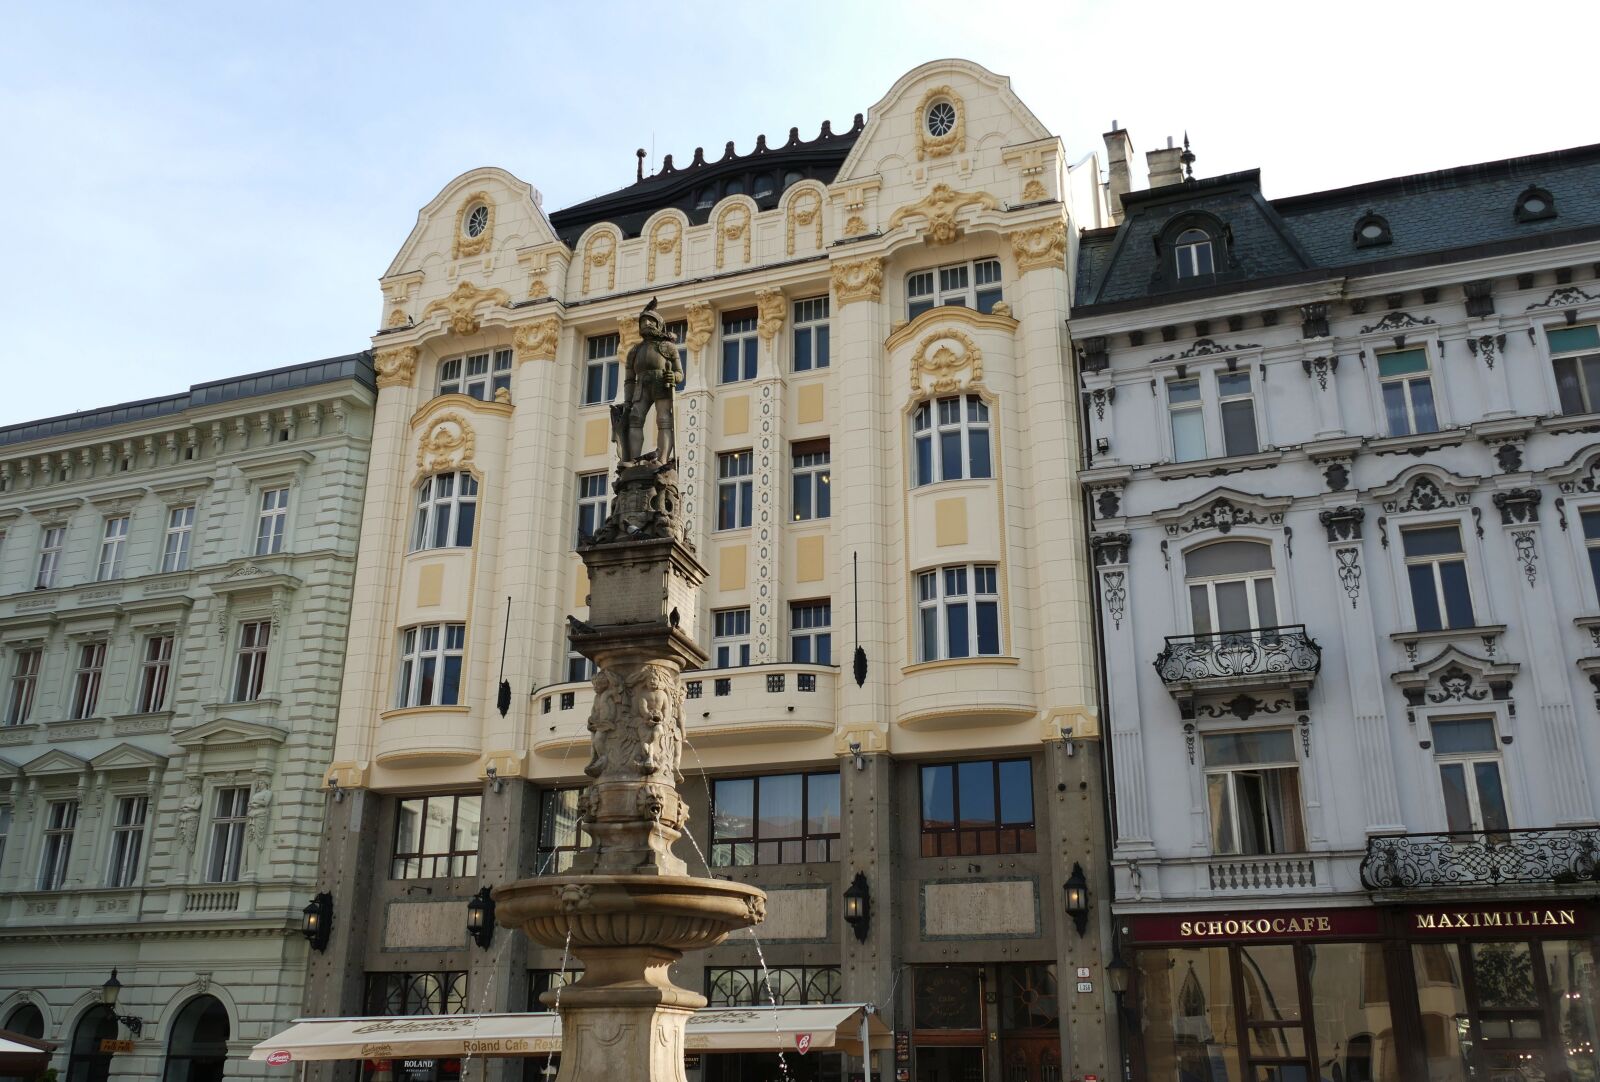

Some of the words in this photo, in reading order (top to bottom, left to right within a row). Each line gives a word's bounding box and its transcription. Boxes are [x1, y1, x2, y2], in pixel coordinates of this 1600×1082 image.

[1180, 916, 1331, 937] SCHOKOCAFE
[1415, 909, 1575, 929] MAXIMILIAN
[463, 1040, 500, 1052] Roland
[505, 1039, 529, 1051] Cafe
[404, 1060, 433, 1068] ROLAND
